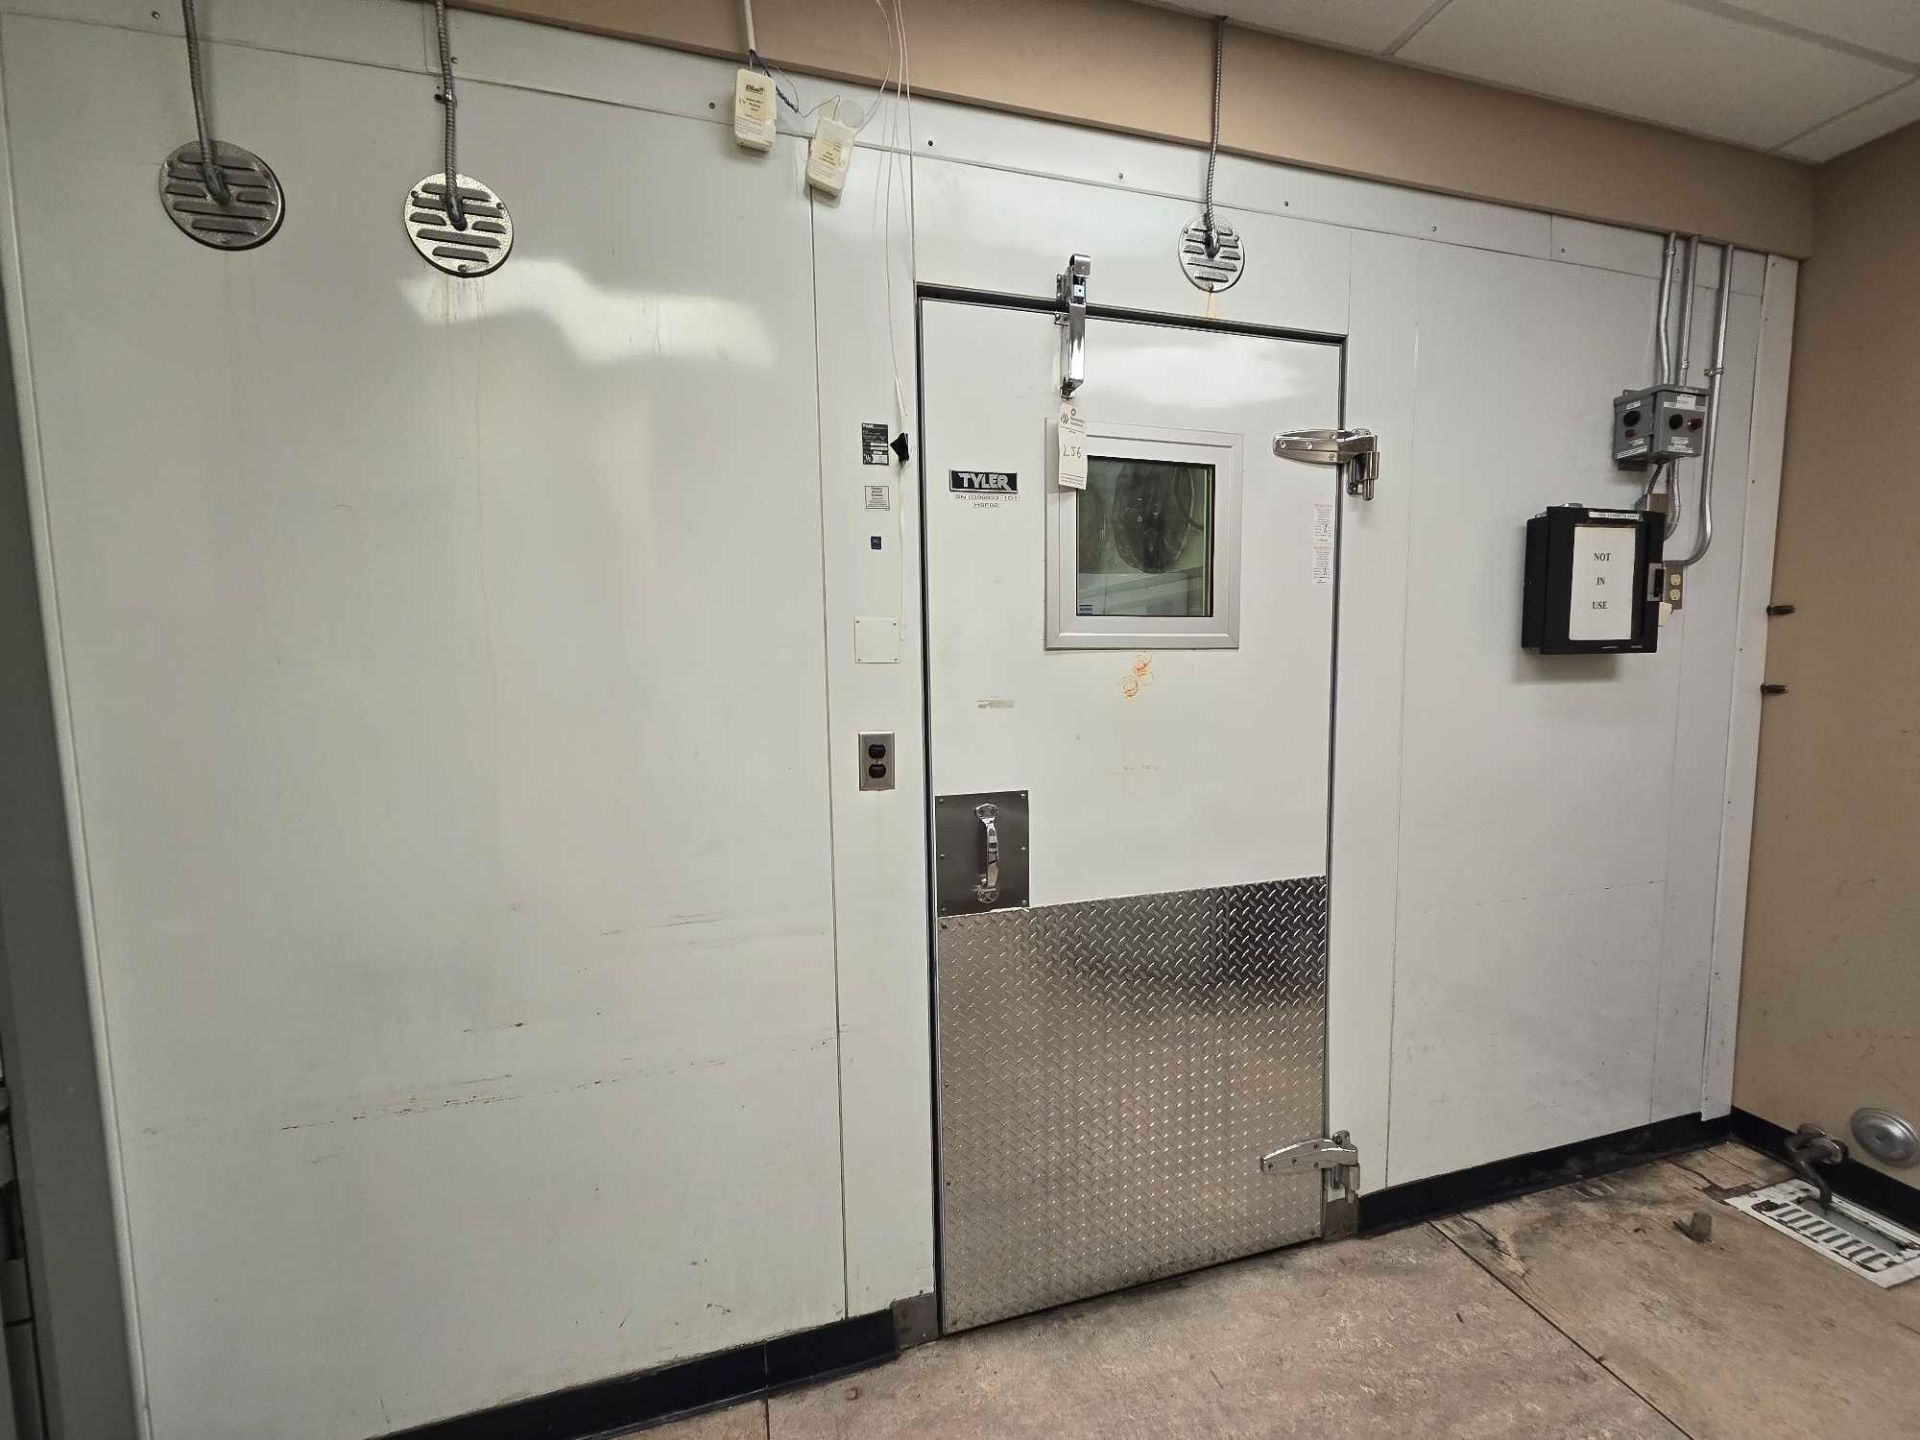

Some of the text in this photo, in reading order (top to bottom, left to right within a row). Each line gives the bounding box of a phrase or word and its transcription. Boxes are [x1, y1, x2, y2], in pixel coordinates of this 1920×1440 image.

[958, 473, 1013, 492] TYLER
[1593, 552, 1612, 562] NOT
[1596, 576, 1606, 586] IN
[1592, 601, 1608, 610] USE
